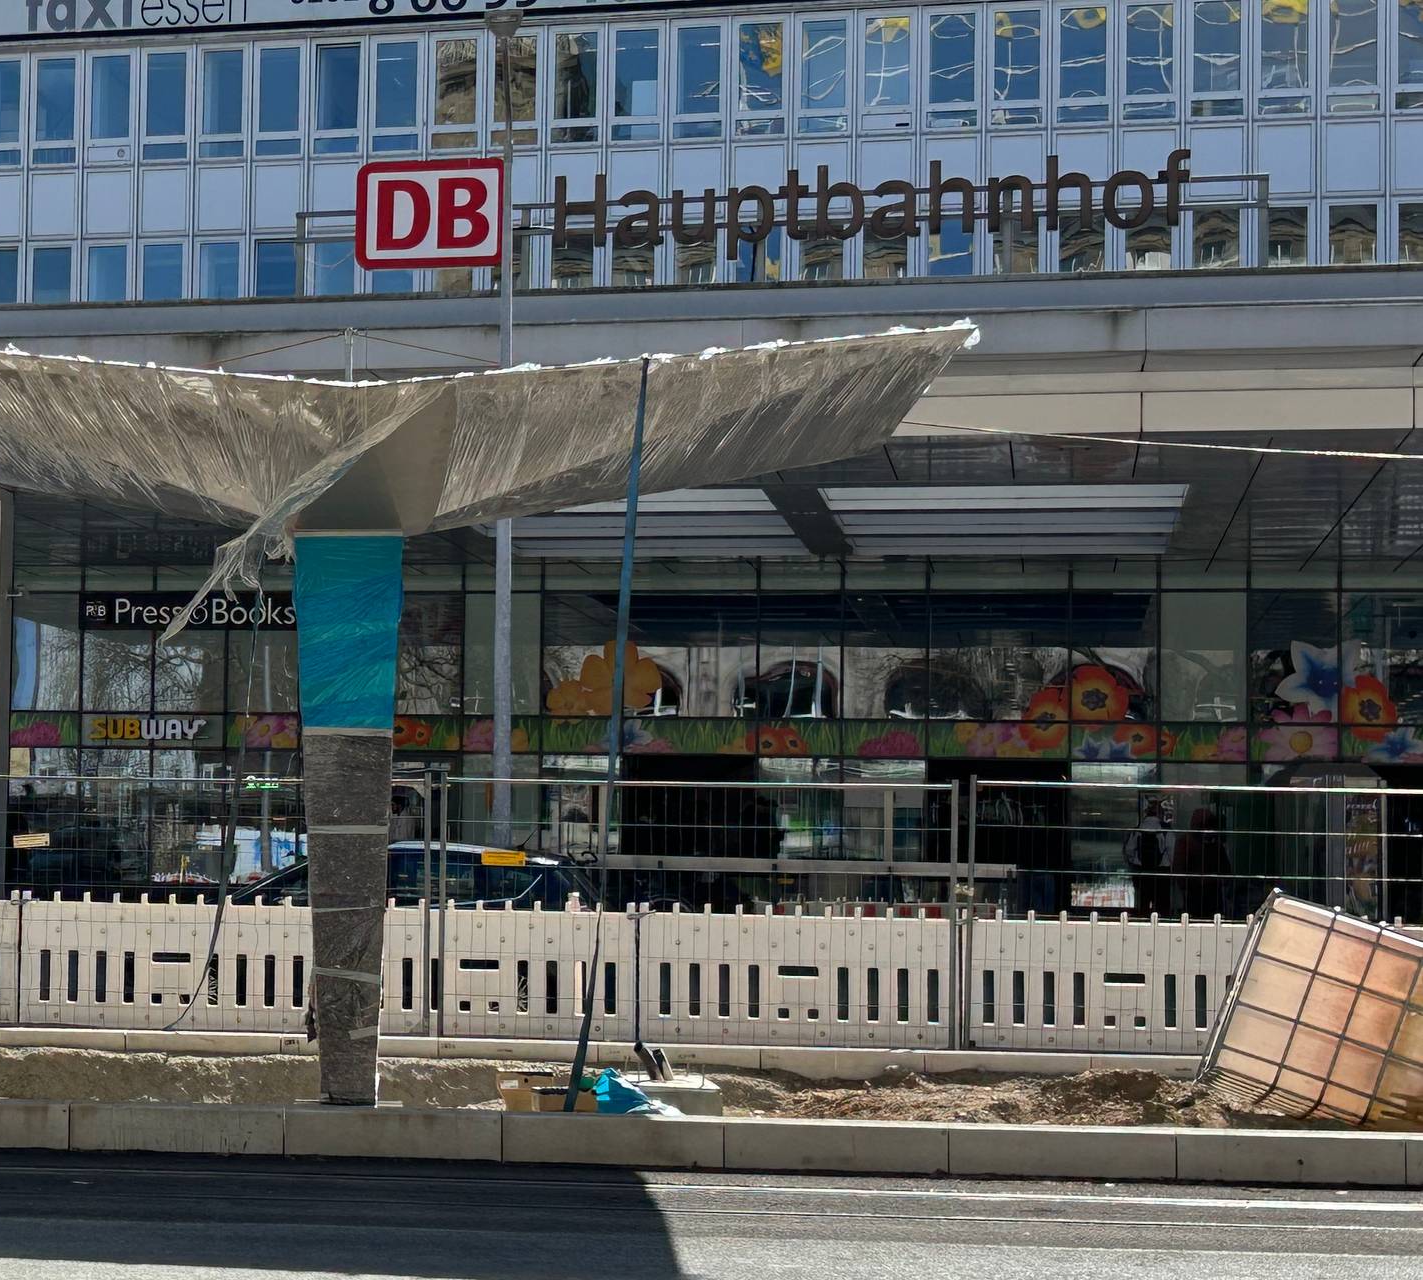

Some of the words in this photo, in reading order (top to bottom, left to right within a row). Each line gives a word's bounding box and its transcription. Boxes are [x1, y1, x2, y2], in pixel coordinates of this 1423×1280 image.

[376, 177, 491, 251] DB
[554, 148, 1191, 261] Hauptbahnhof
[212, 598, 296, 625] Books
[90, 719, 207, 740] SUBWAY
